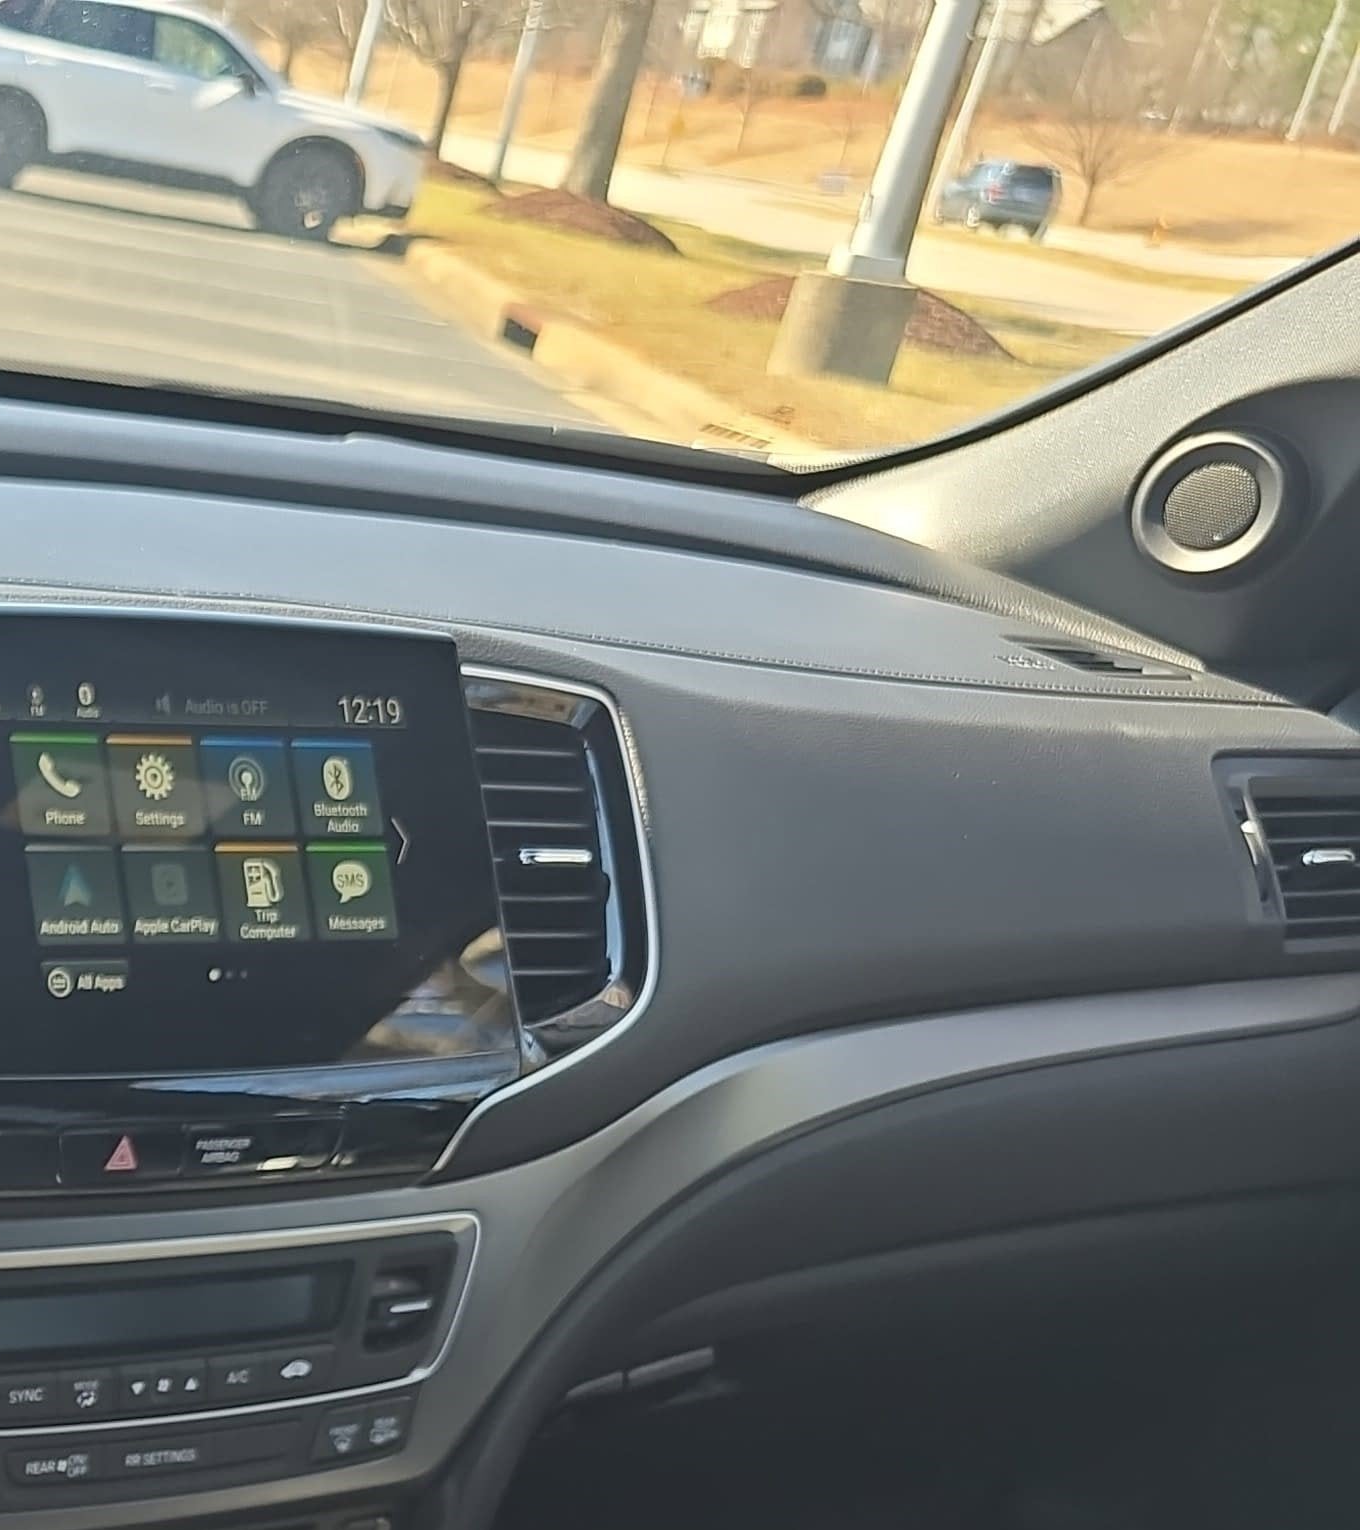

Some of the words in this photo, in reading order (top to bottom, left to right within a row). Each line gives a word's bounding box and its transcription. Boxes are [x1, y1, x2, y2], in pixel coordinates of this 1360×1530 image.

[184, 699, 224, 715] Audio
[242, 700, 268, 715] OFF
[338, 696, 401, 725] 12:19
[45, 808, 86, 826] Phone
[242, 811, 263, 826] FM
[313, 802, 368, 818] Bluetooth
[135, 810, 185, 828] Settings
[326, 819, 360, 834] Audio
[336, 872, 365, 889] SMS
[254, 909, 278, 925] Trip
[328, 916, 385, 933] Messages
[40, 919, 89, 936] Android
[91, 919, 121, 935] Auto
[134, 917, 169, 936] Apple
[170, 916, 217, 936] CarPlay
[240, 925, 296, 942] Computer
[77, 972, 92, 991] All
[94, 972, 126, 992] Apps
[226, 1368, 250, 1385] A/C
[8, 1387, 46, 1405] SYNC
[125, 1454, 141, 1467] RR
[142, 1448, 198, 1466] SETTINGS
[25, 1459, 56, 1476] REAR
[66, 1465, 88, 1478] OFF
